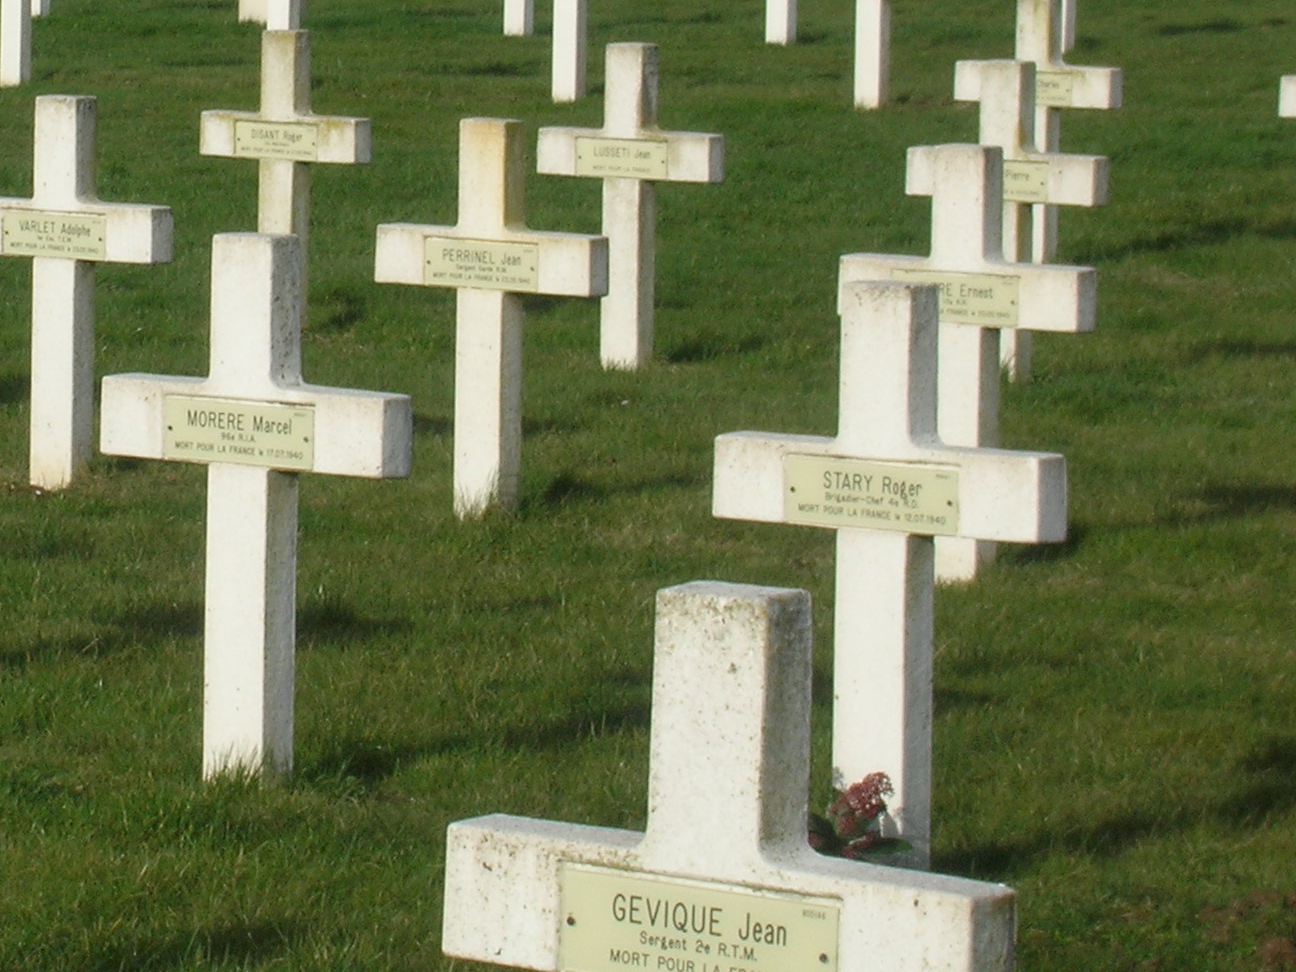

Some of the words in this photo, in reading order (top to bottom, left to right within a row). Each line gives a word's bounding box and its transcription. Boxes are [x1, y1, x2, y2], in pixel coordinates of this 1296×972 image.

[634, 149, 651, 159] Jean
[19, 219, 55, 234] VARLET
[60, 223, 91, 238] Adolphe
[442, 248, 495, 265] PERRINEL
[501, 252, 521, 266] Jean
[960, 283, 994, 300] Ernest
[187, 409, 245, 431] MORERE
[252, 415, 292, 435] Marcel
[174, 440, 194, 449] MORT
[196, 442, 214, 452] POUR
[217, 445, 226, 453] LA
[229, 446, 255, 456] FRANCE
[823, 470, 873, 493] STARY
[882, 476, 923, 500] Roger
[824, 491, 884, 506] Brigadier-Chef
[797, 503, 819, 513] MORT
[823, 505, 843, 515] POUR
[847, 508, 858, 517] LA
[861, 509, 891, 520] FRANCE
[612, 893, 723, 938] GEVIQUE
[739, 912, 787, 947] Jean
[639, 930, 688, 952] Sergent
[695, 939, 711, 955] 2e
[717, 942, 758, 962] R.T.M.
[609, 948, 650, 968] MORT
[657, 956, 696, 972] POUR
